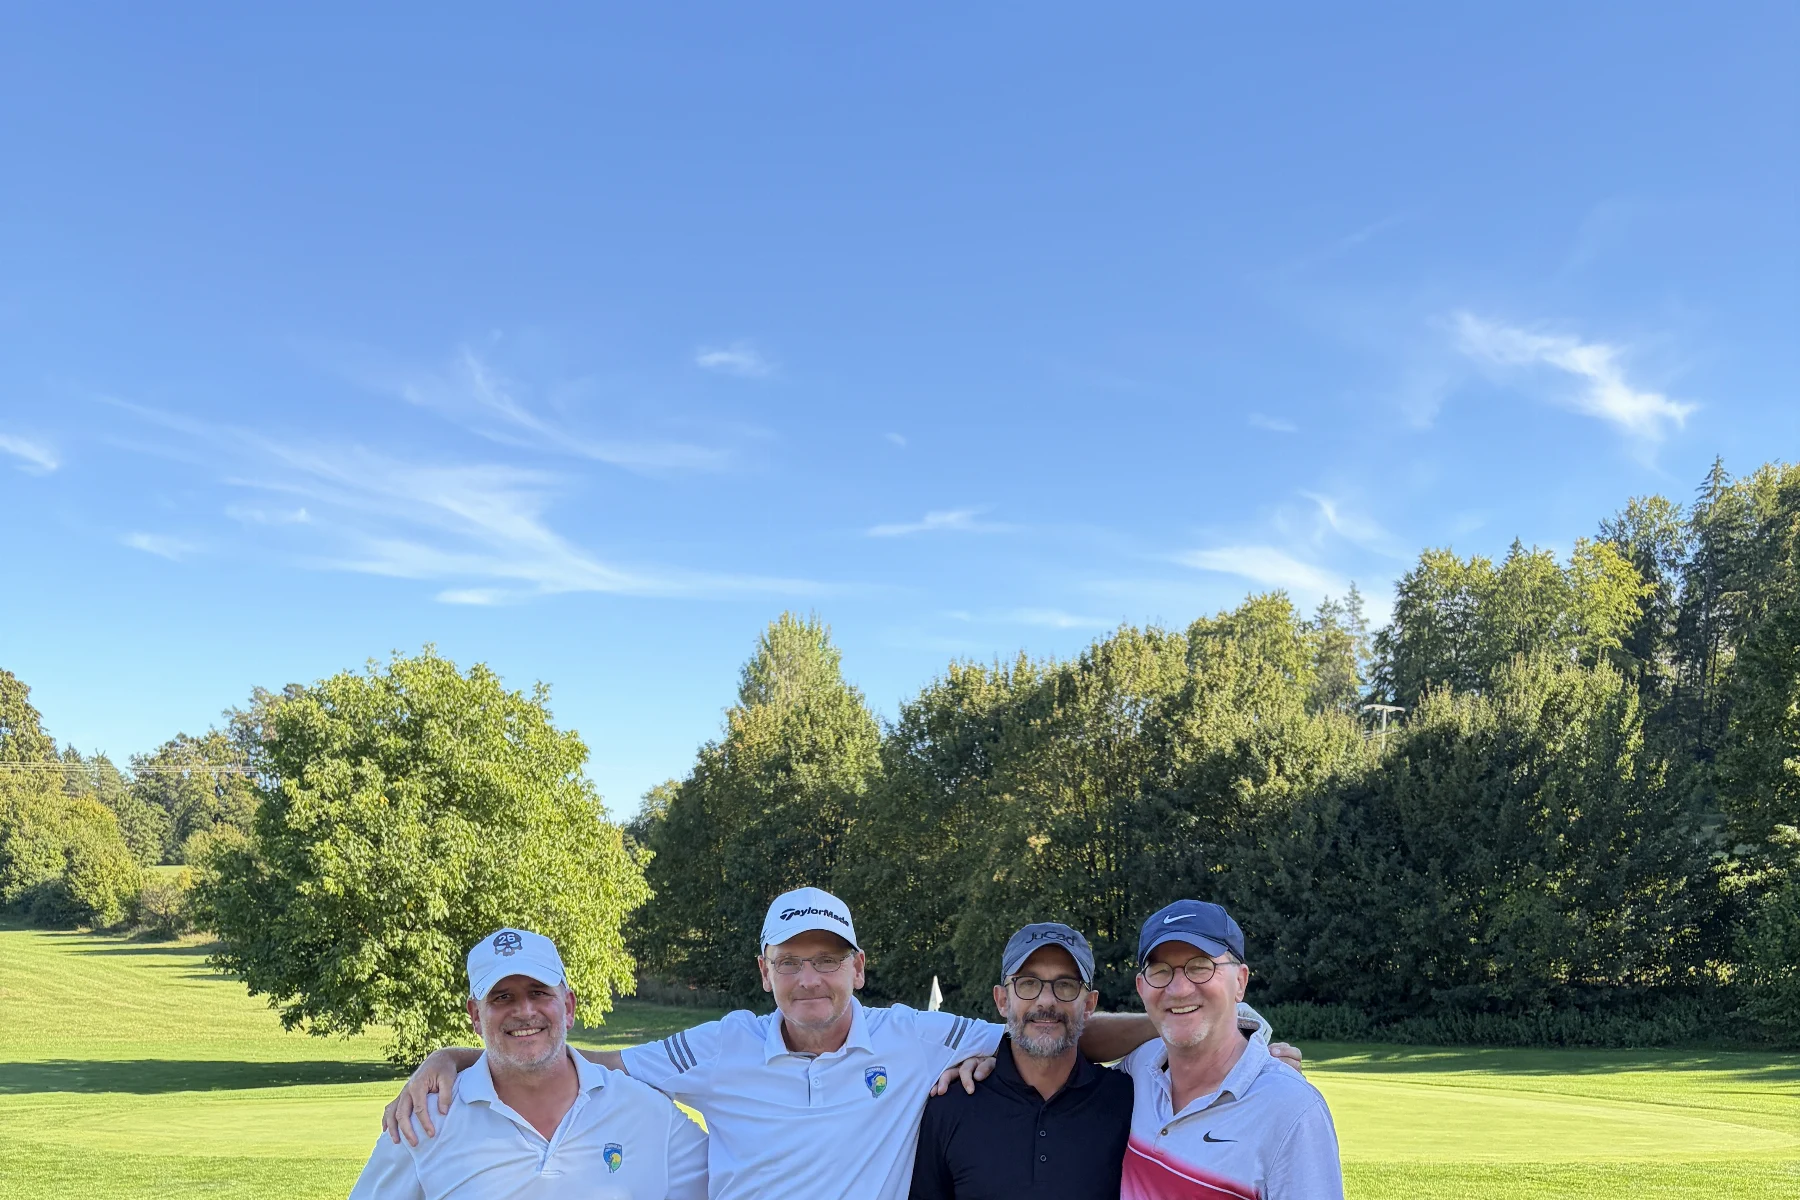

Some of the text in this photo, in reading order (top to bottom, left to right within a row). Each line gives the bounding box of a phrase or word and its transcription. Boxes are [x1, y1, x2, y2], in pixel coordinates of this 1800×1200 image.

[780, 906, 849, 926] TaylorMade
[499, 933, 516, 945] 26
[1025, 930, 1075, 946] JuCad
